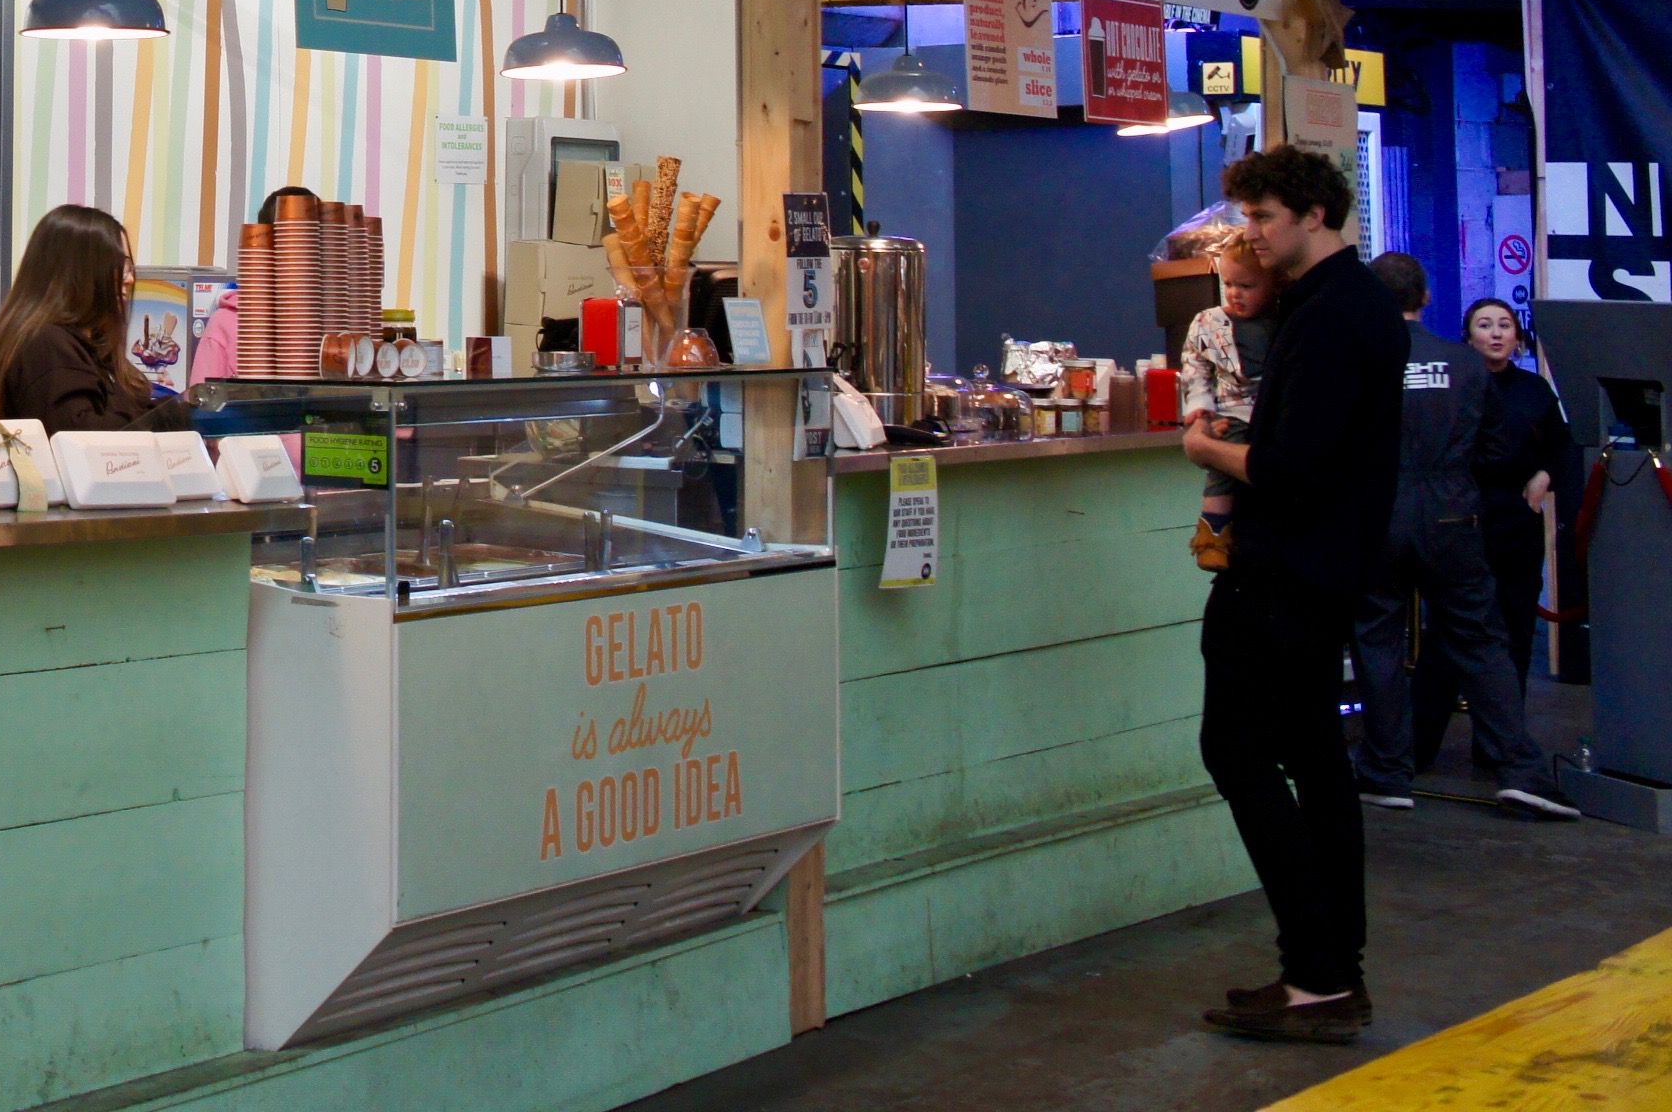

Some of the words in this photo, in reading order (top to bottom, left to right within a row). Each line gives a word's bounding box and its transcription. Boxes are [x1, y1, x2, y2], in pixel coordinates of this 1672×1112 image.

[1106, 20, 1120, 57] HOT
[1121, 22, 1162, 63] CHOCOLATE
[1023, 50, 1051, 65] whole
[1025, 79, 1052, 96] slice
[439, 123, 454, 131] FOOD
[455, 124, 484, 132] ALLERGIES
[442, 142, 482, 150] INTOLERANCES
[794, 211, 812, 224] SMALL
[802, 226, 822, 241] GELATO
[803, 270, 818, 309] 5
[329, 437, 358, 445] HYGIENE
[105, 458, 141, 476] Badiani
[371, 460, 379, 472] 5
[584, 601, 704, 688] GELATO
[571, 710, 598, 761] is
[608, 682, 714, 760] always
[540, 786, 563, 862] A
[576, 767, 661, 854] GOOD
[673, 750, 742, 830] IDEA
